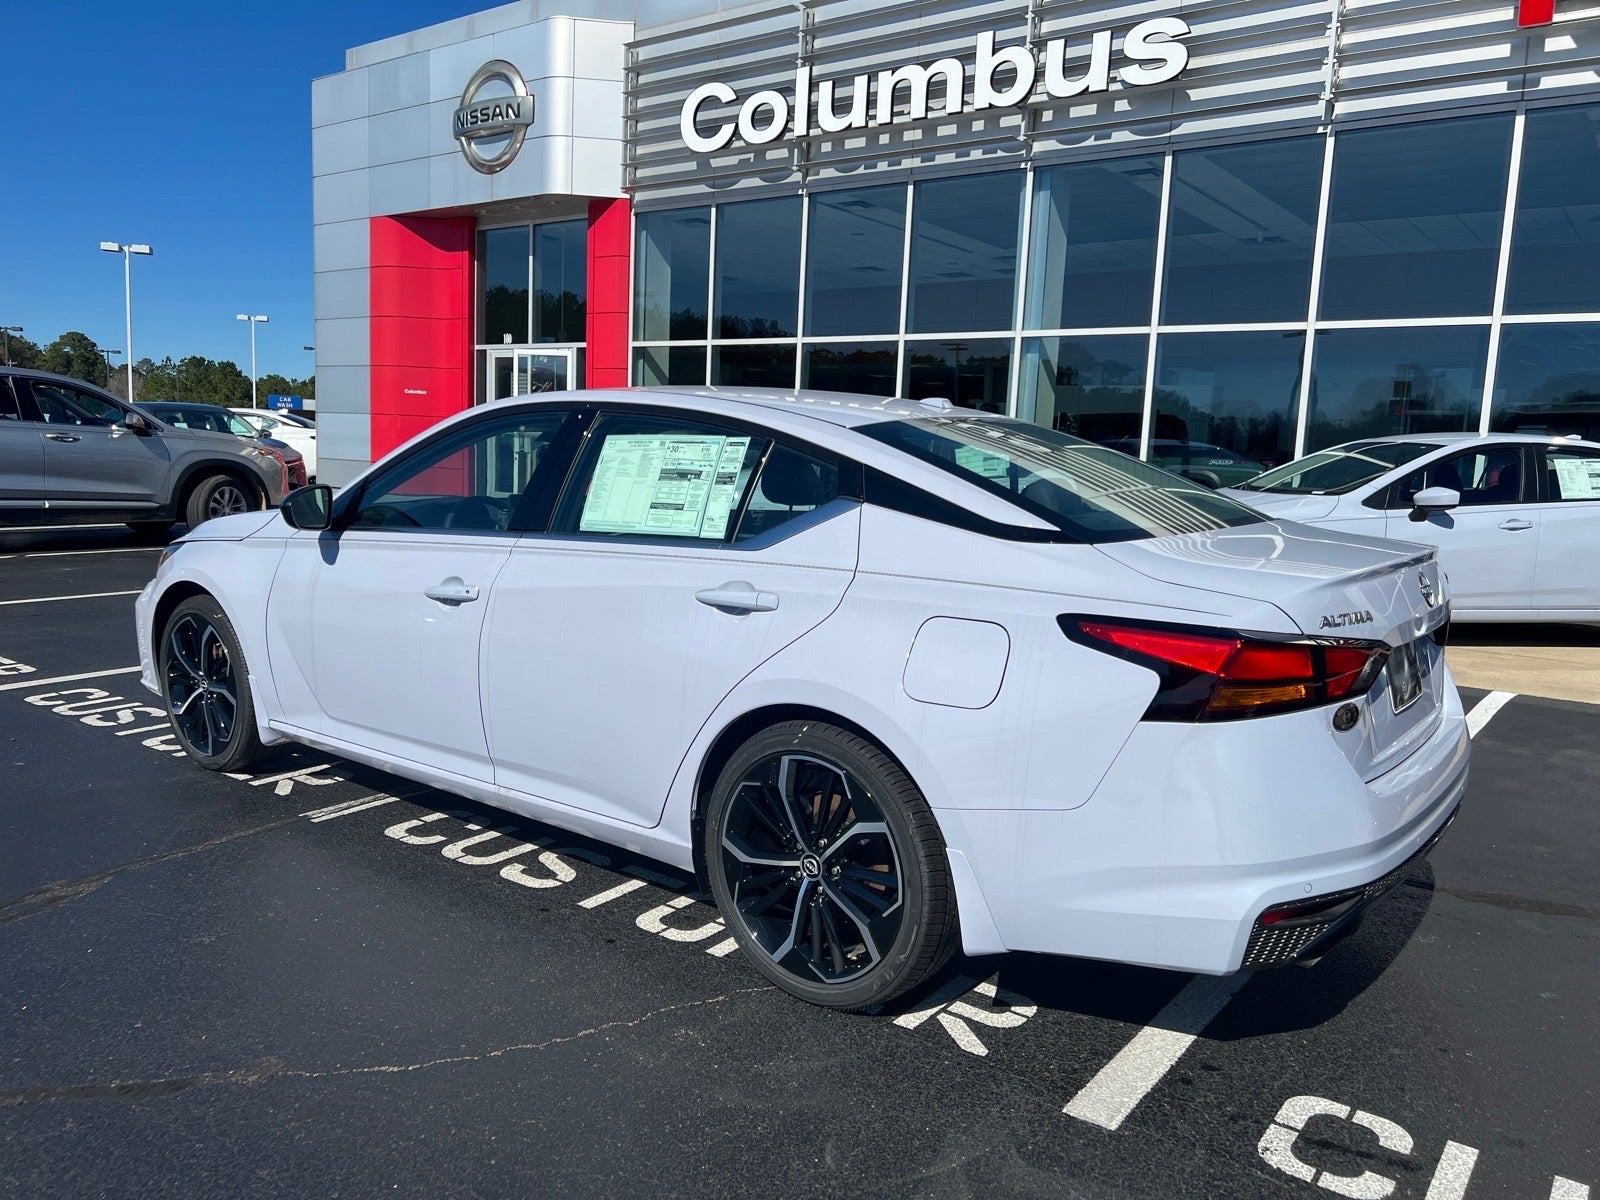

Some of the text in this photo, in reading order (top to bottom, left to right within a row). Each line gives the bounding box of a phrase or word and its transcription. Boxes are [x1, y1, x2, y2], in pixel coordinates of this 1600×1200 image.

[680, 17, 1192, 153] Columbus
[456, 102, 521, 129] NISSAN
[503, 333, 513, 344] 100
[669, 445, 680, 453] 30
[1319, 610, 1374, 629] ALTIMA
